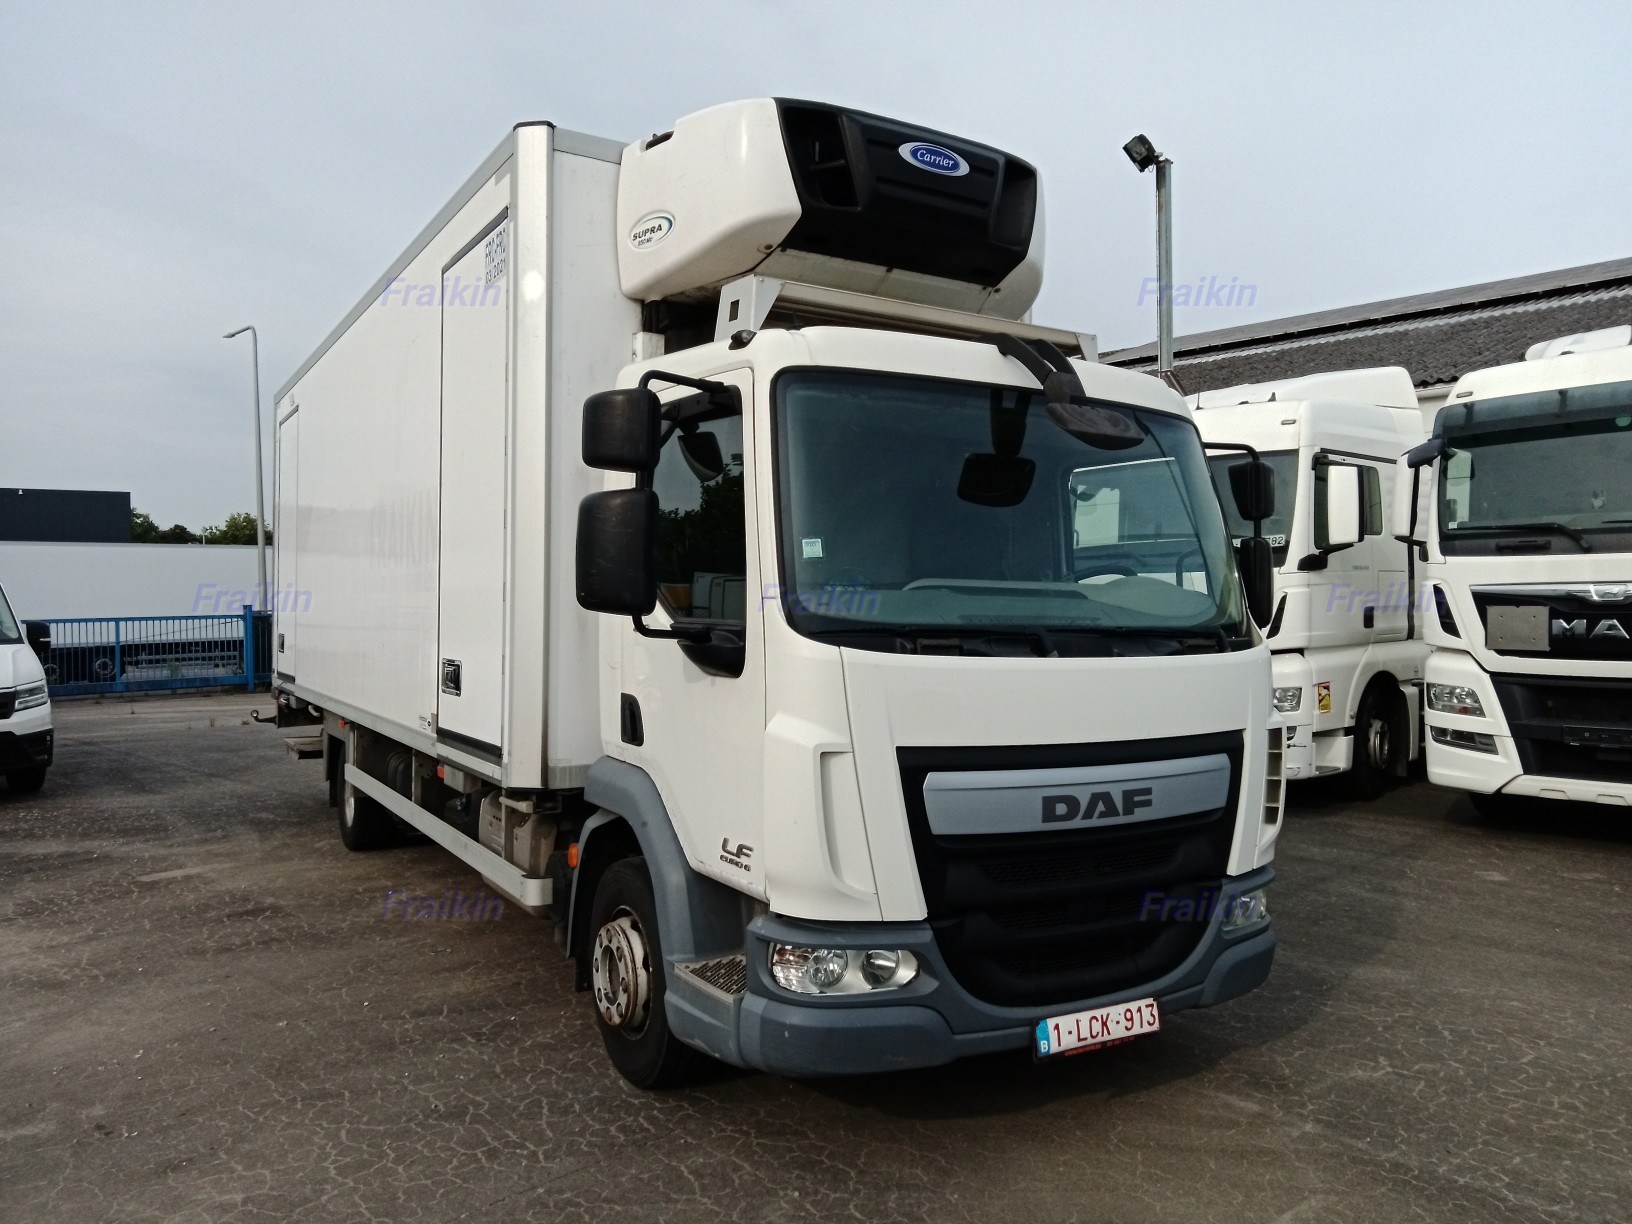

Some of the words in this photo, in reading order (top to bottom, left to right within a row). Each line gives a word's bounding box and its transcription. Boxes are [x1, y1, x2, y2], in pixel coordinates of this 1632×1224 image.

[917, 150, 954, 167] Carrier
[632, 223, 662, 241] SUPRA
[1042, 787, 1152, 823] DAF
[721, 837, 754, 859] LF
[1053, 1003, 1156, 1047] 1-LCK-913
[1040, 1041, 1048, 1052] B
